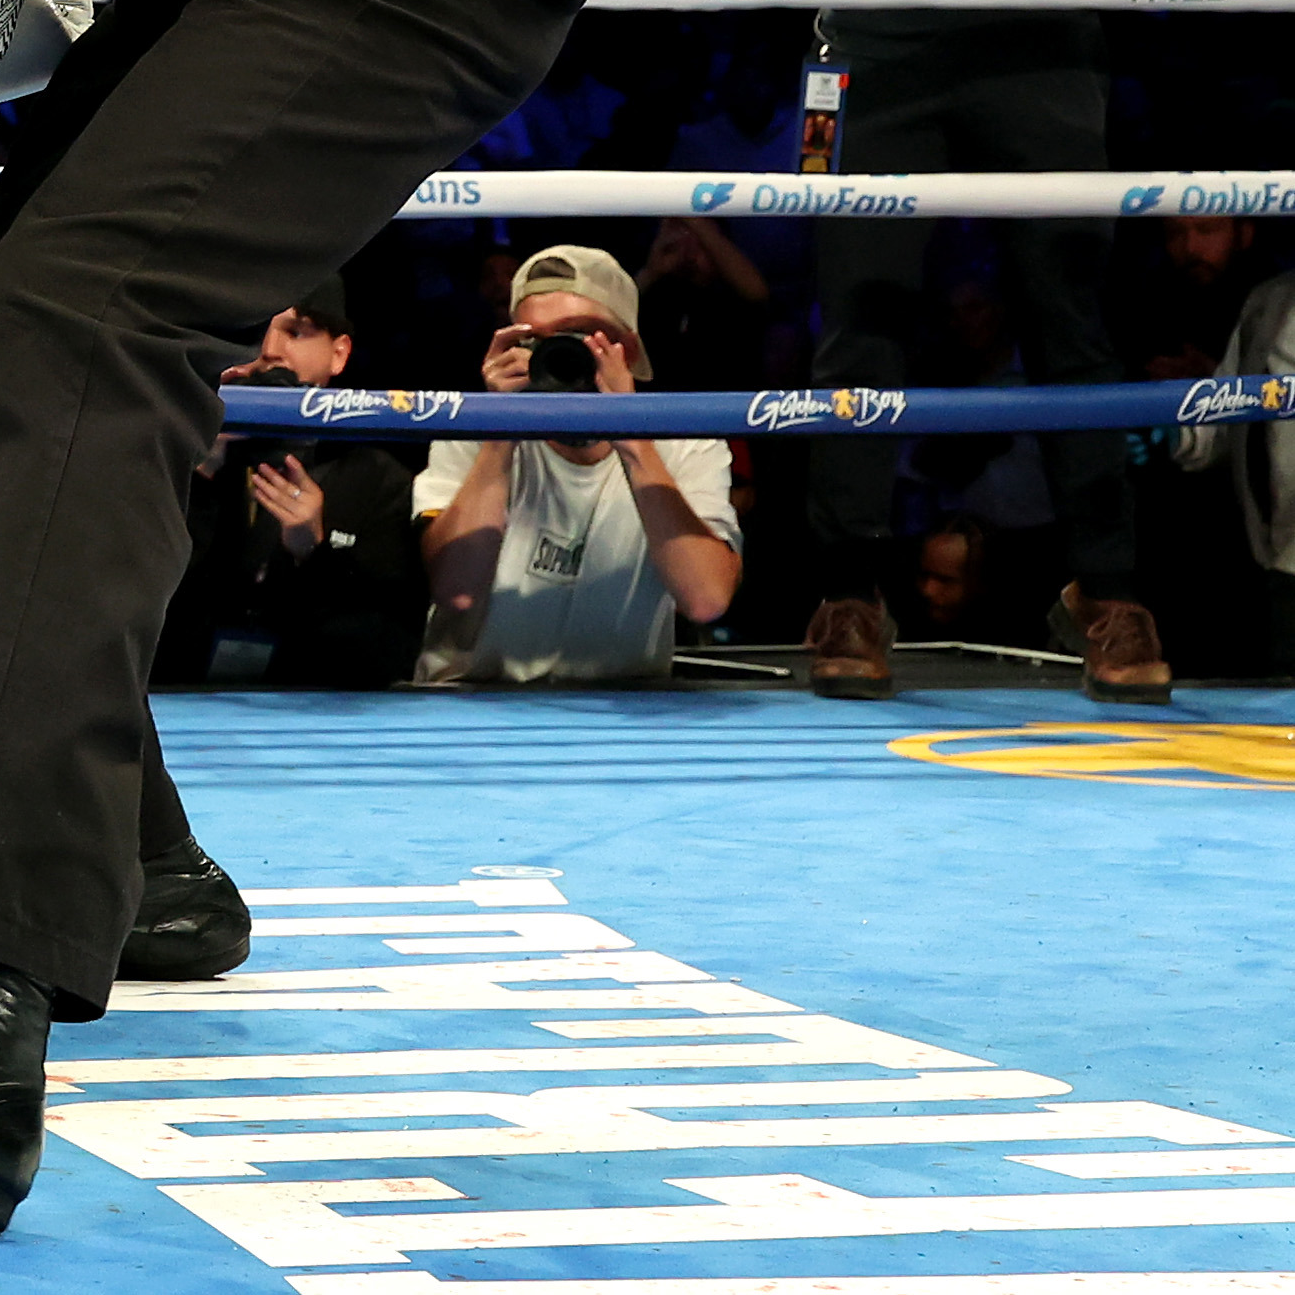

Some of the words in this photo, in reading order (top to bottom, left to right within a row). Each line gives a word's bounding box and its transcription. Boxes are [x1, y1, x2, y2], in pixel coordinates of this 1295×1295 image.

[753, 184, 918, 215] OnlyFans
[300, 387, 389, 424] Golden
[747, 389, 832, 431] Golden
[853, 387, 906, 427] Boy
[1177, 377, 1261, 423] Golden
